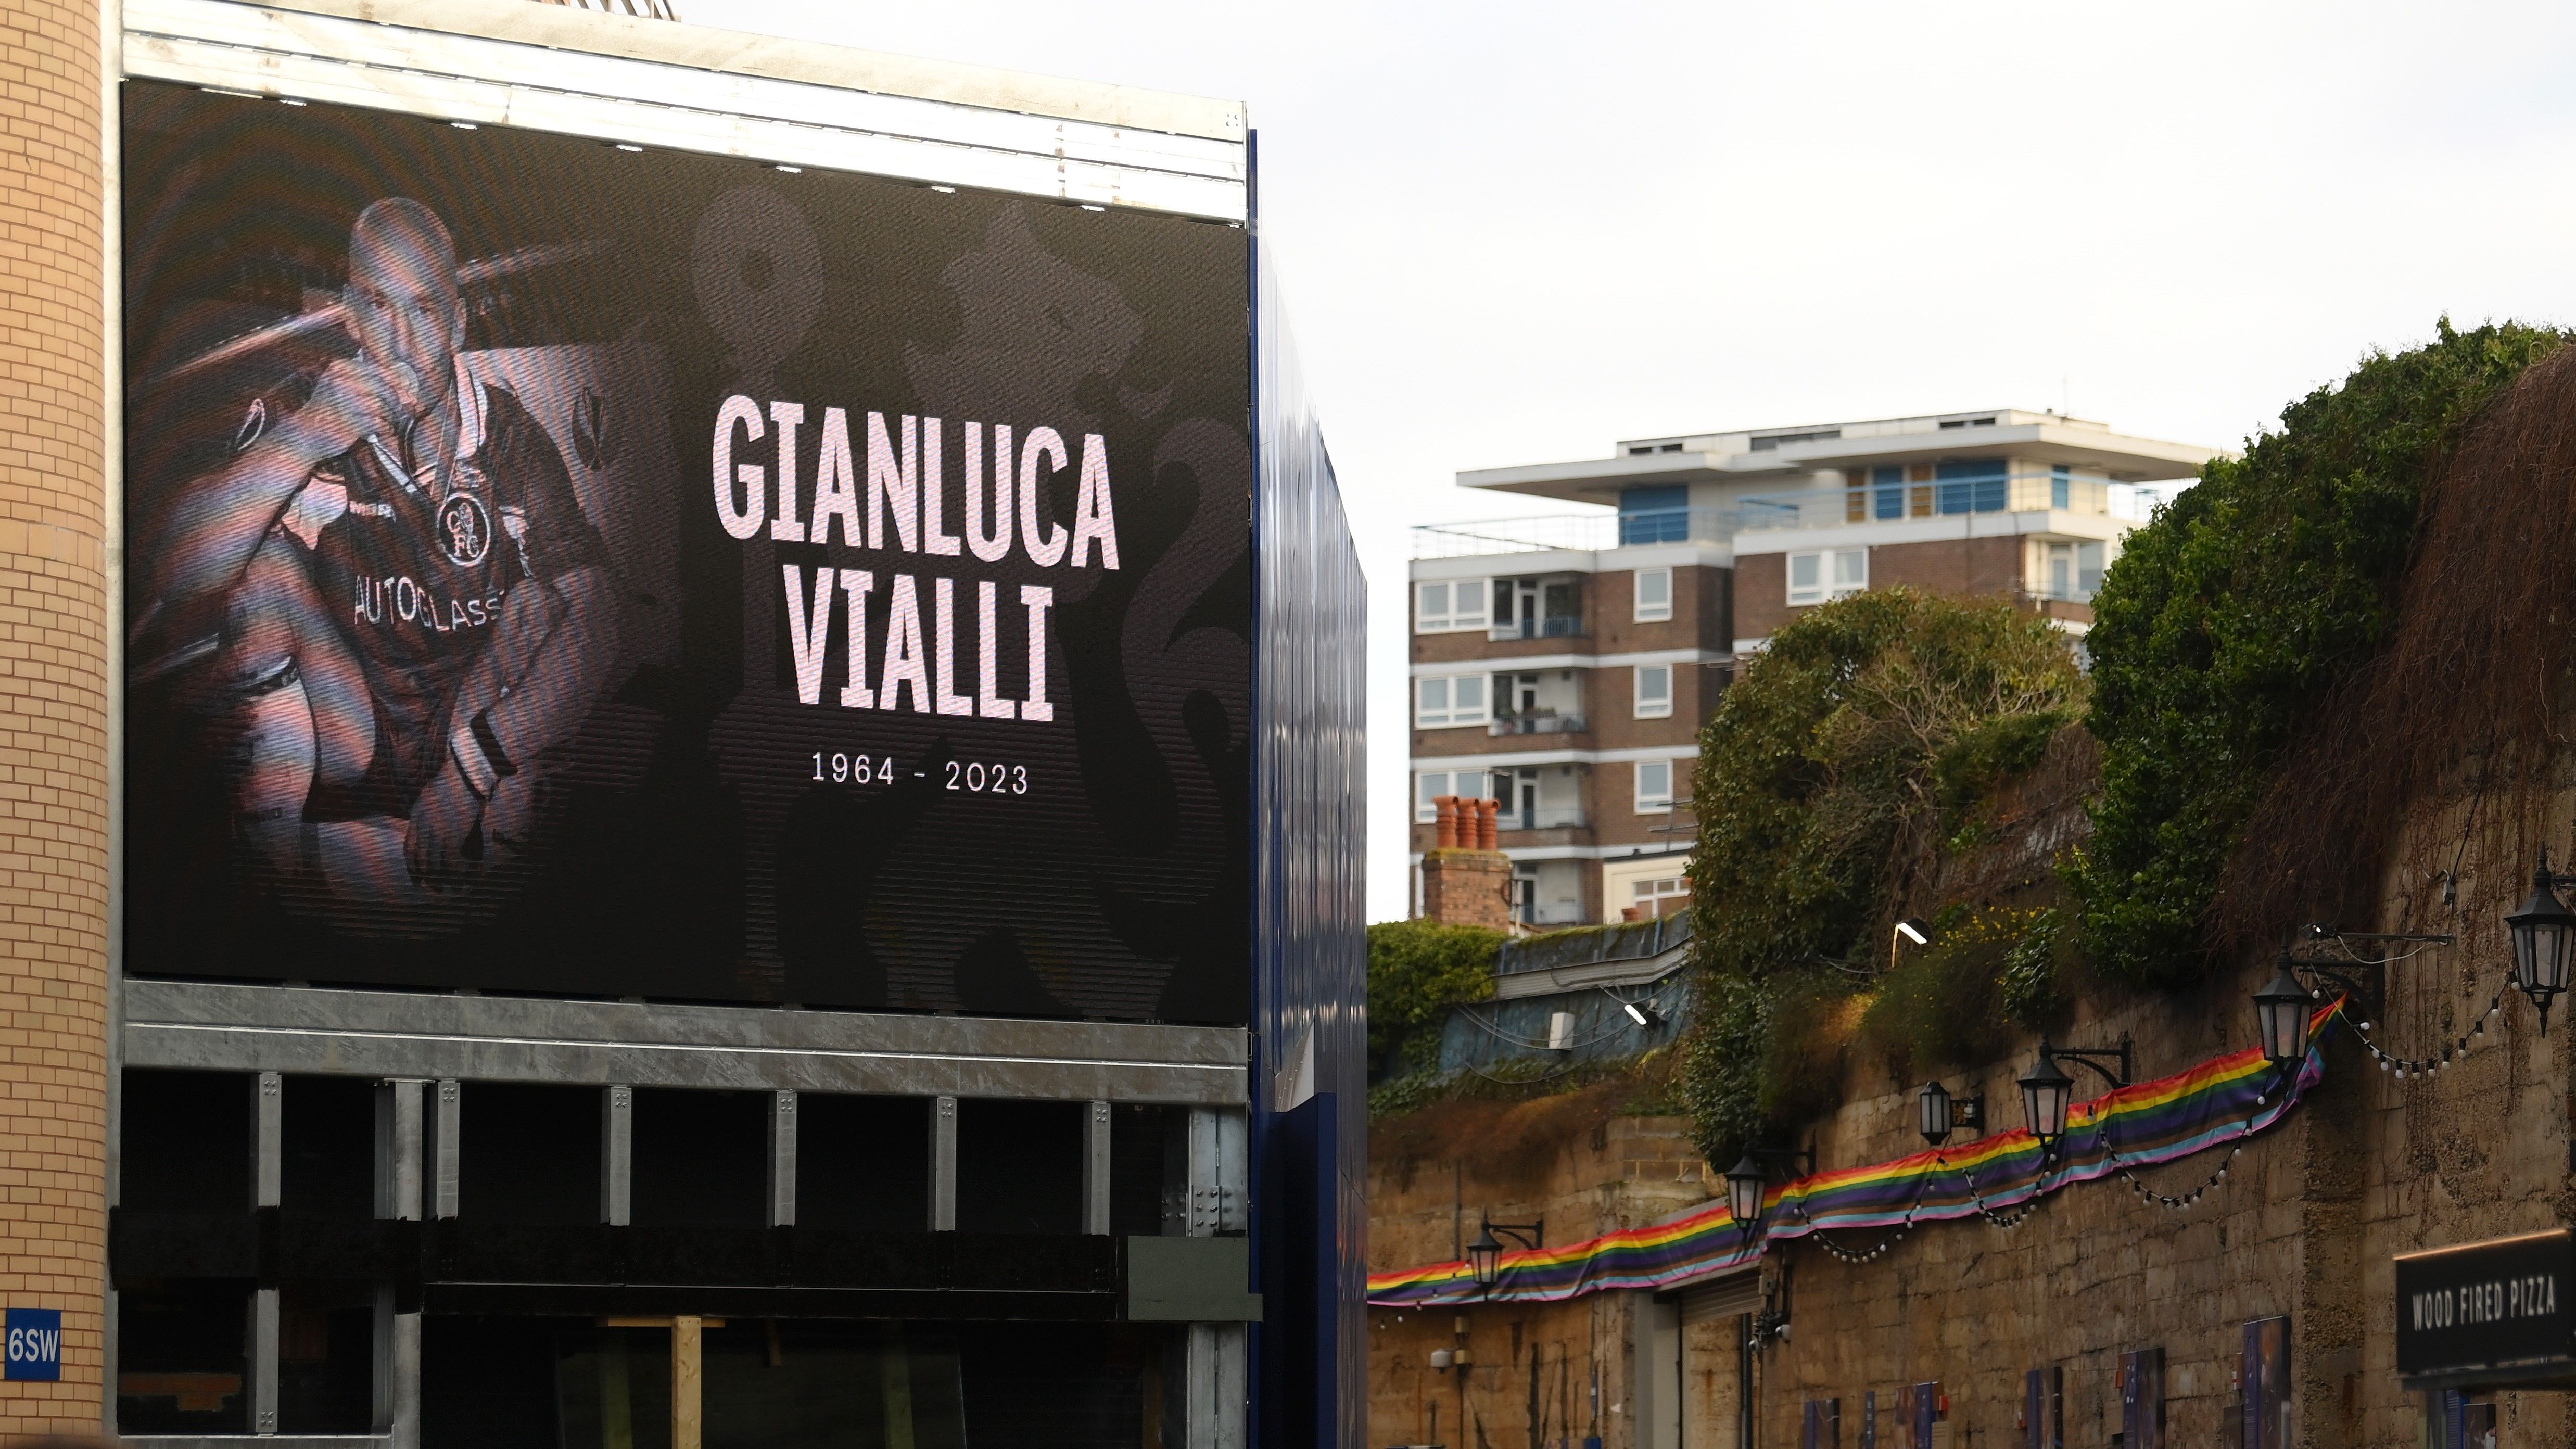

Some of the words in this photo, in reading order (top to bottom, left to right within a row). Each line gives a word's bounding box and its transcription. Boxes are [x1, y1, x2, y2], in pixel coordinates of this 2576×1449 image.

[713, 394, 1120, 570] GIANLUCA
[354, 575, 502, 632] AUTOGLASS
[782, 564, 1054, 722] VIALLI
[811, 752, 894, 785] 1964
[945, 760, 1028, 795] 2023
[2412, 1289, 2454, 1331] WOOD
[2459, 1282, 2503, 1325] FIRED
[2510, 1275, 2556, 1318] PIZZA
[9, 1327, 59, 1362] 6SW
